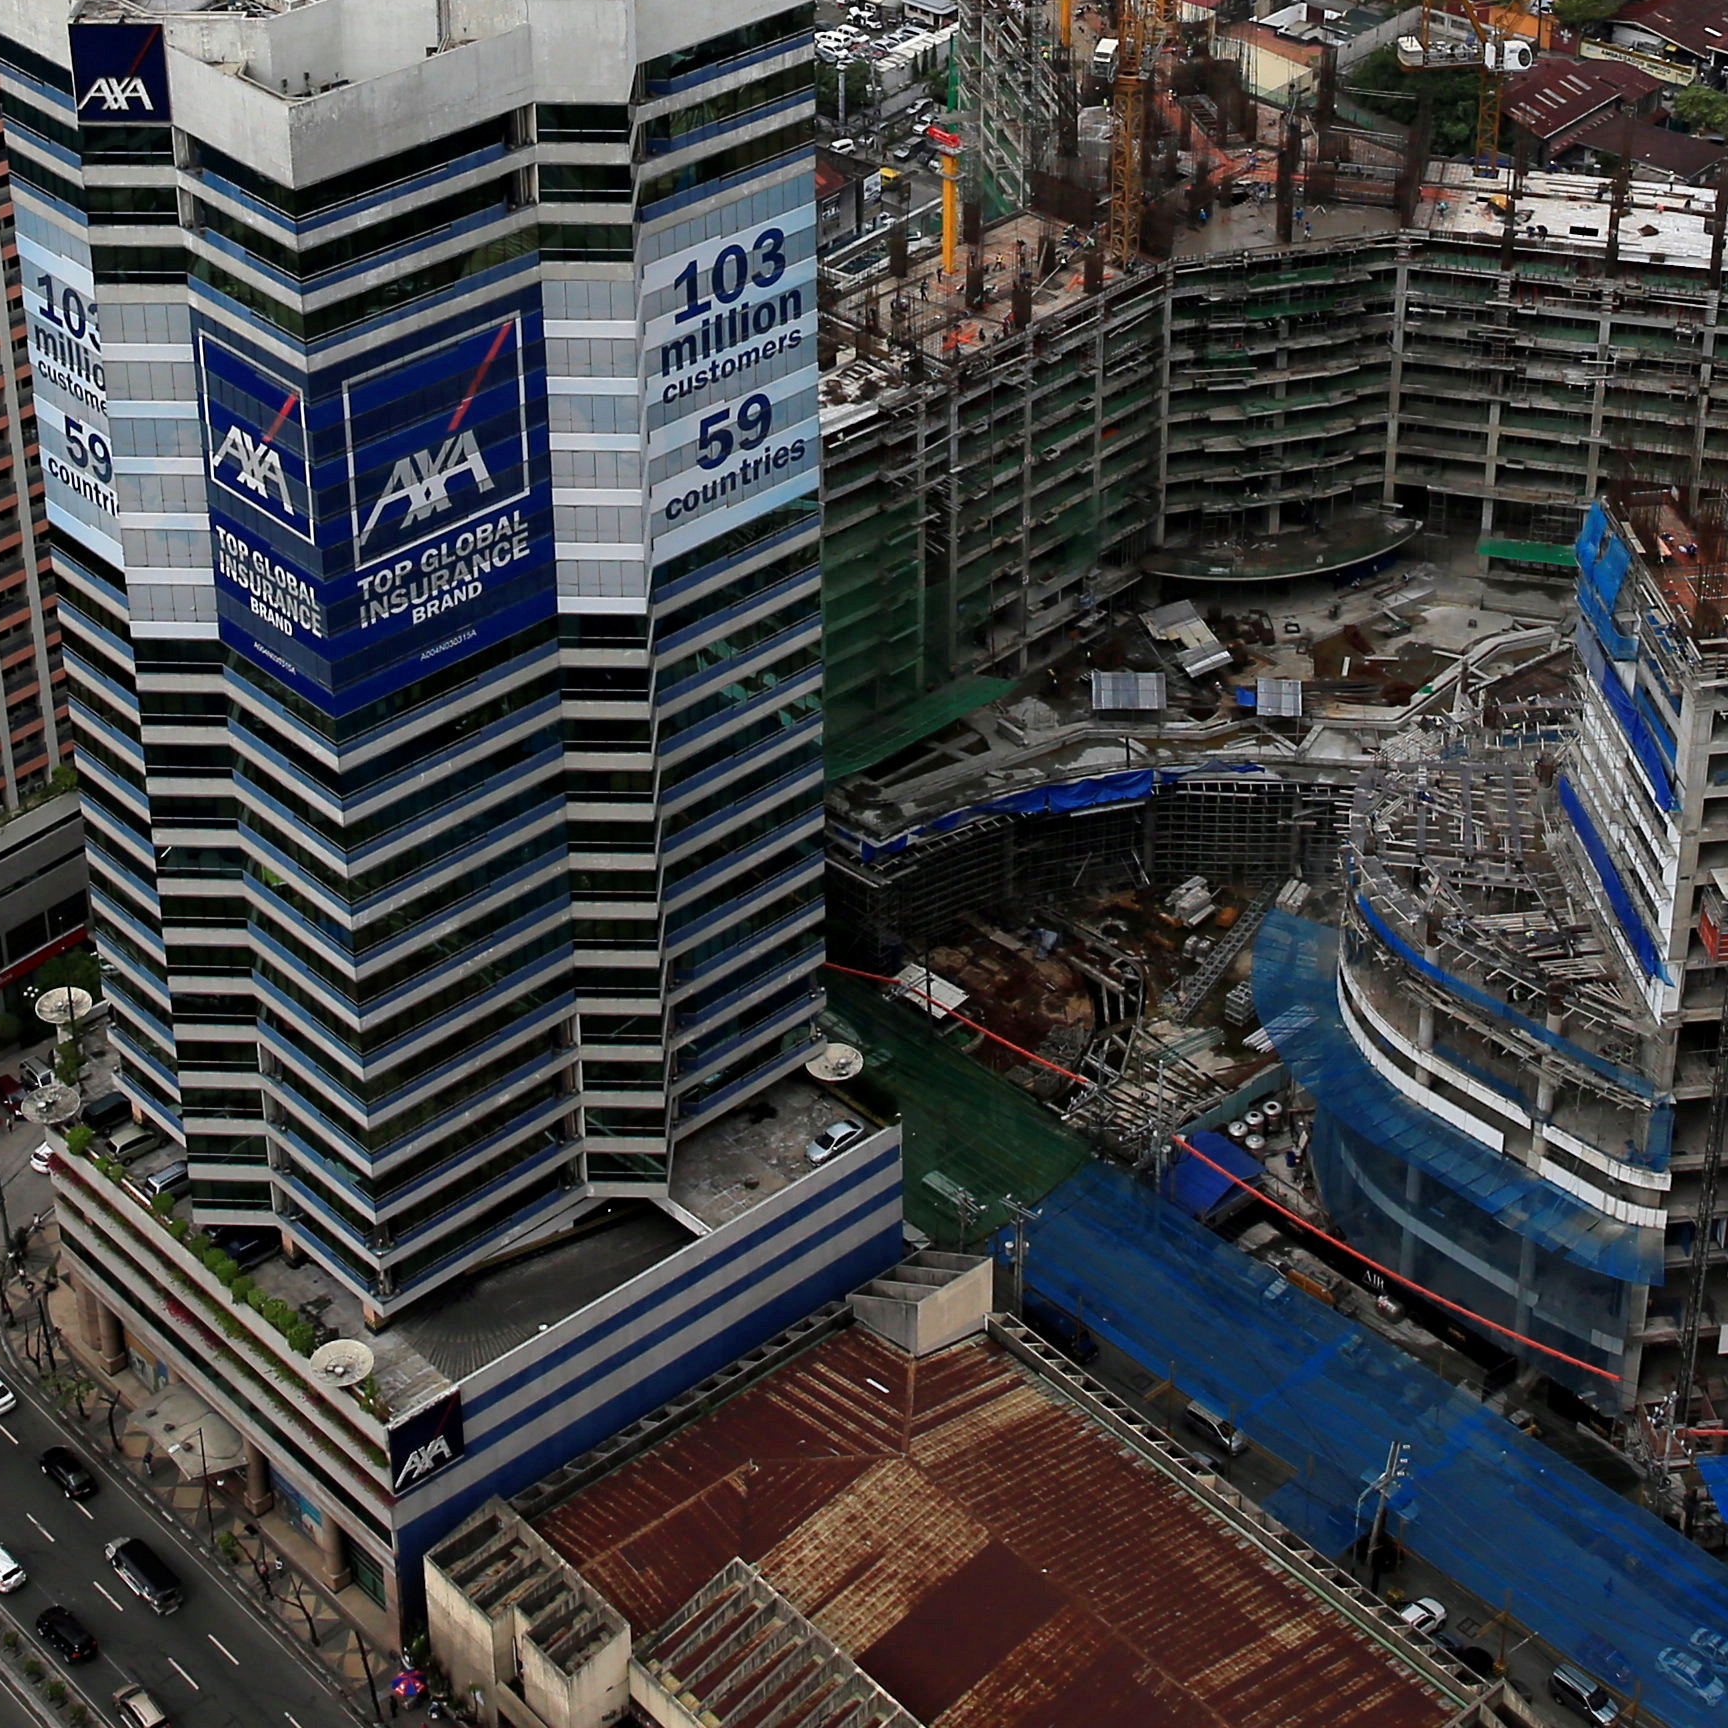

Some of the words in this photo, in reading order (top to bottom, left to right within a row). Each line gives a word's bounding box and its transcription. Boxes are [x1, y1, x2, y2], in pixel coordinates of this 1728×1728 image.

[77, 76, 154, 111] AXA
[673, 227, 786, 325] 103
[661, 287, 802, 377] million
[662, 328, 802, 404] customers
[65, 414, 113, 485] 59
[213, 423, 295, 516] AXA
[696, 393, 772, 470] 59
[47, 456, 120, 520] countri
[360, 429, 496, 547] AXA
[665, 438, 806, 521] countries
[215, 524, 249, 561] TOP
[252, 550, 320, 612] GLOBAL
[219, 549, 323, 639] INSURANCE
[357, 560, 413, 600] TOP
[420, 509, 529, 573] GLOBAL
[359, 531, 530, 629] INSURANCE
[250, 595, 293, 638] BRAND
[412, 581, 483, 625] BRAND
[395, 1434, 453, 1489] AXA
